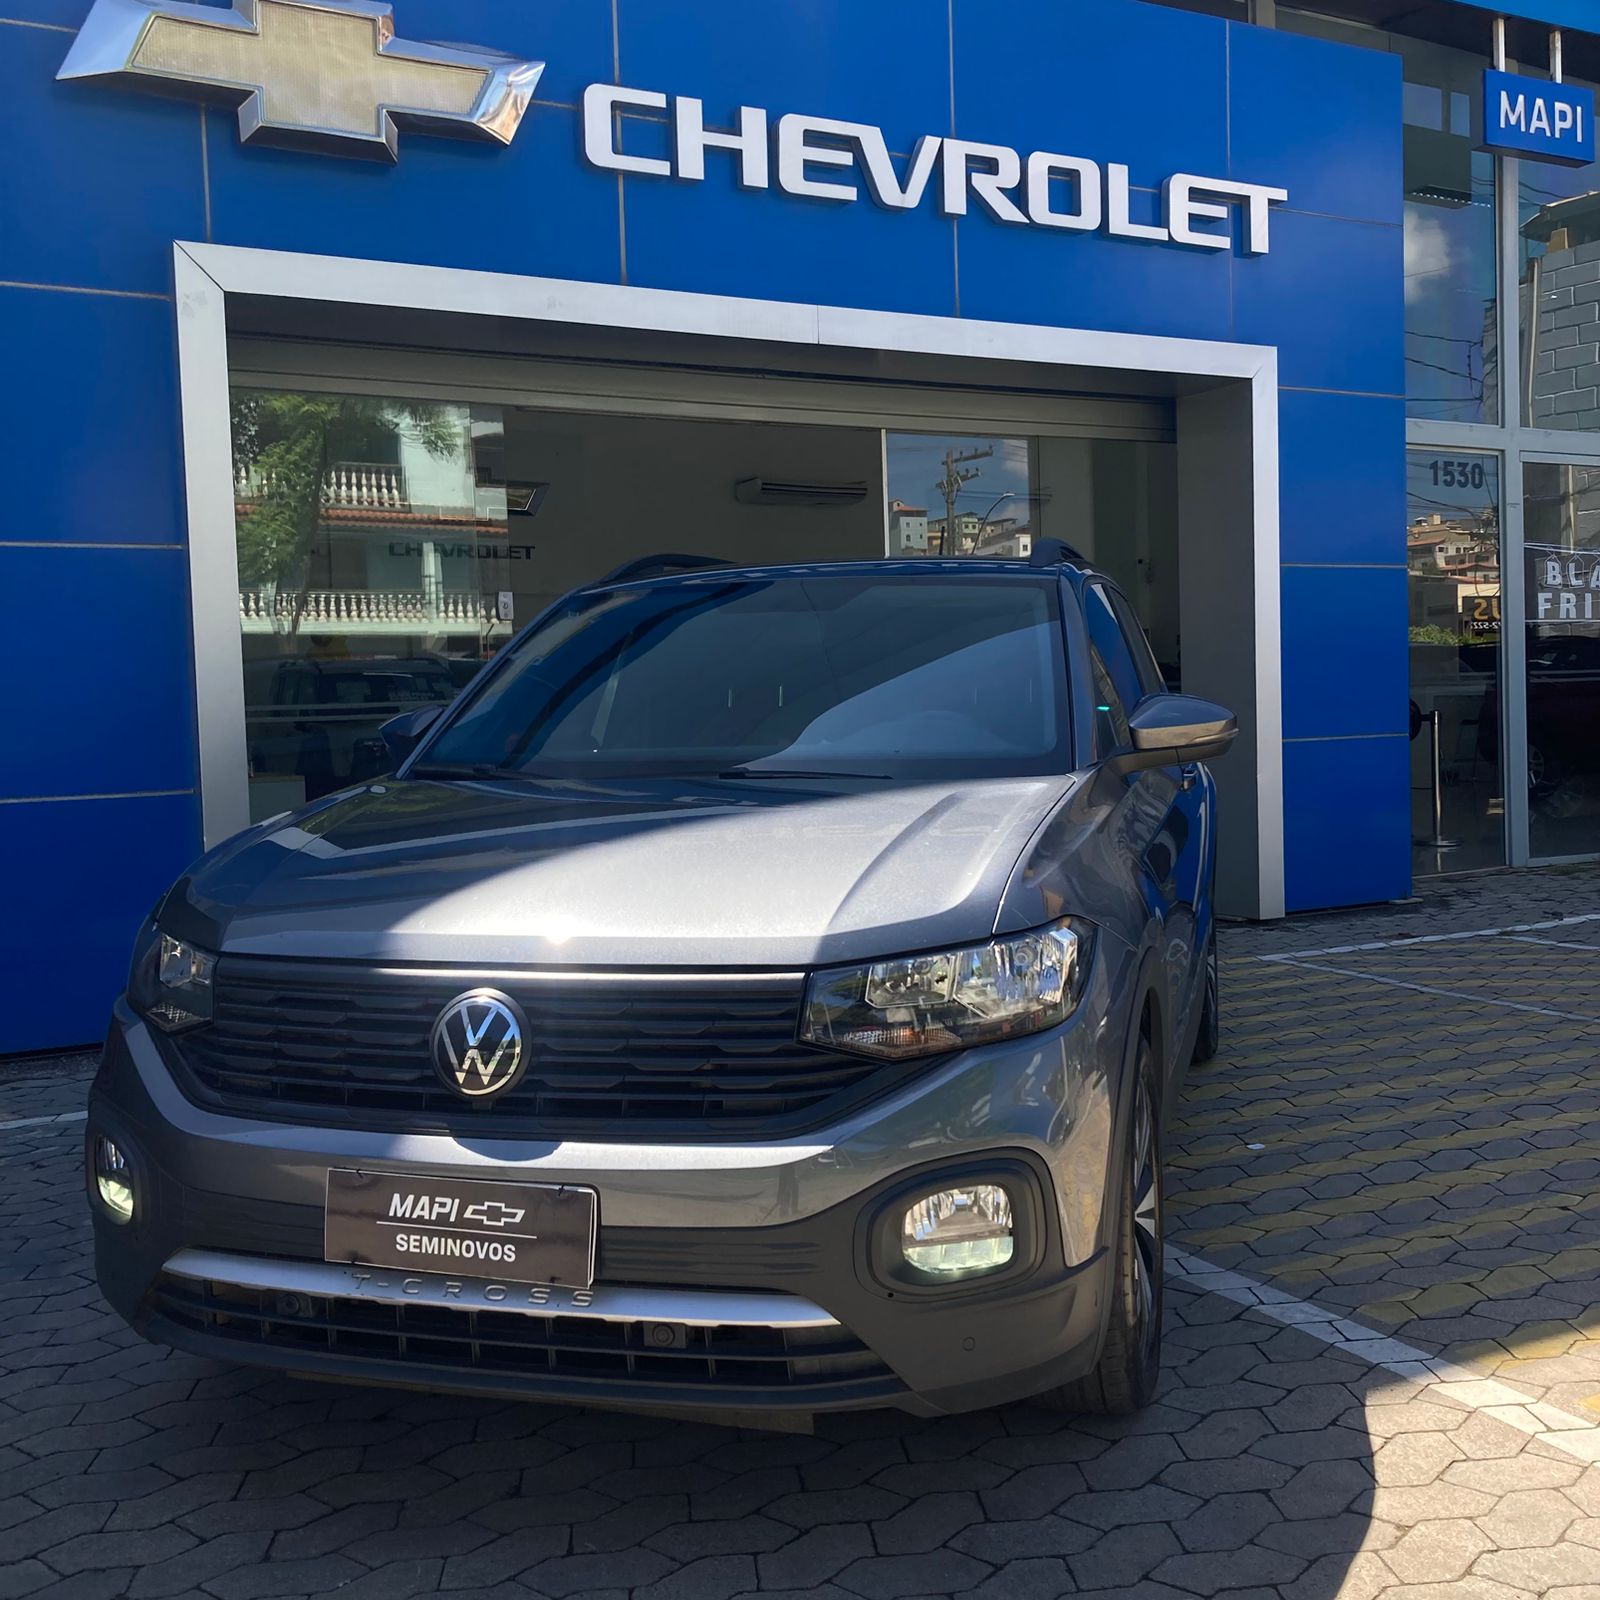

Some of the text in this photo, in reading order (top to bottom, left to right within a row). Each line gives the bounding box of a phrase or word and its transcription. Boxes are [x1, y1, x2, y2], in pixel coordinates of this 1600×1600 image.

[1499, 91, 1582, 143] MAPI
[583, 83, 1289, 256] CHEVROLET
[1429, 460, 1484, 489] 1530
[437, 1001, 520, 1092] VW
[388, 1193, 460, 1223] MAPI
[396, 1233, 516, 1263] SEMINOVOS
[352, 1274, 594, 1308] T-CROSS
